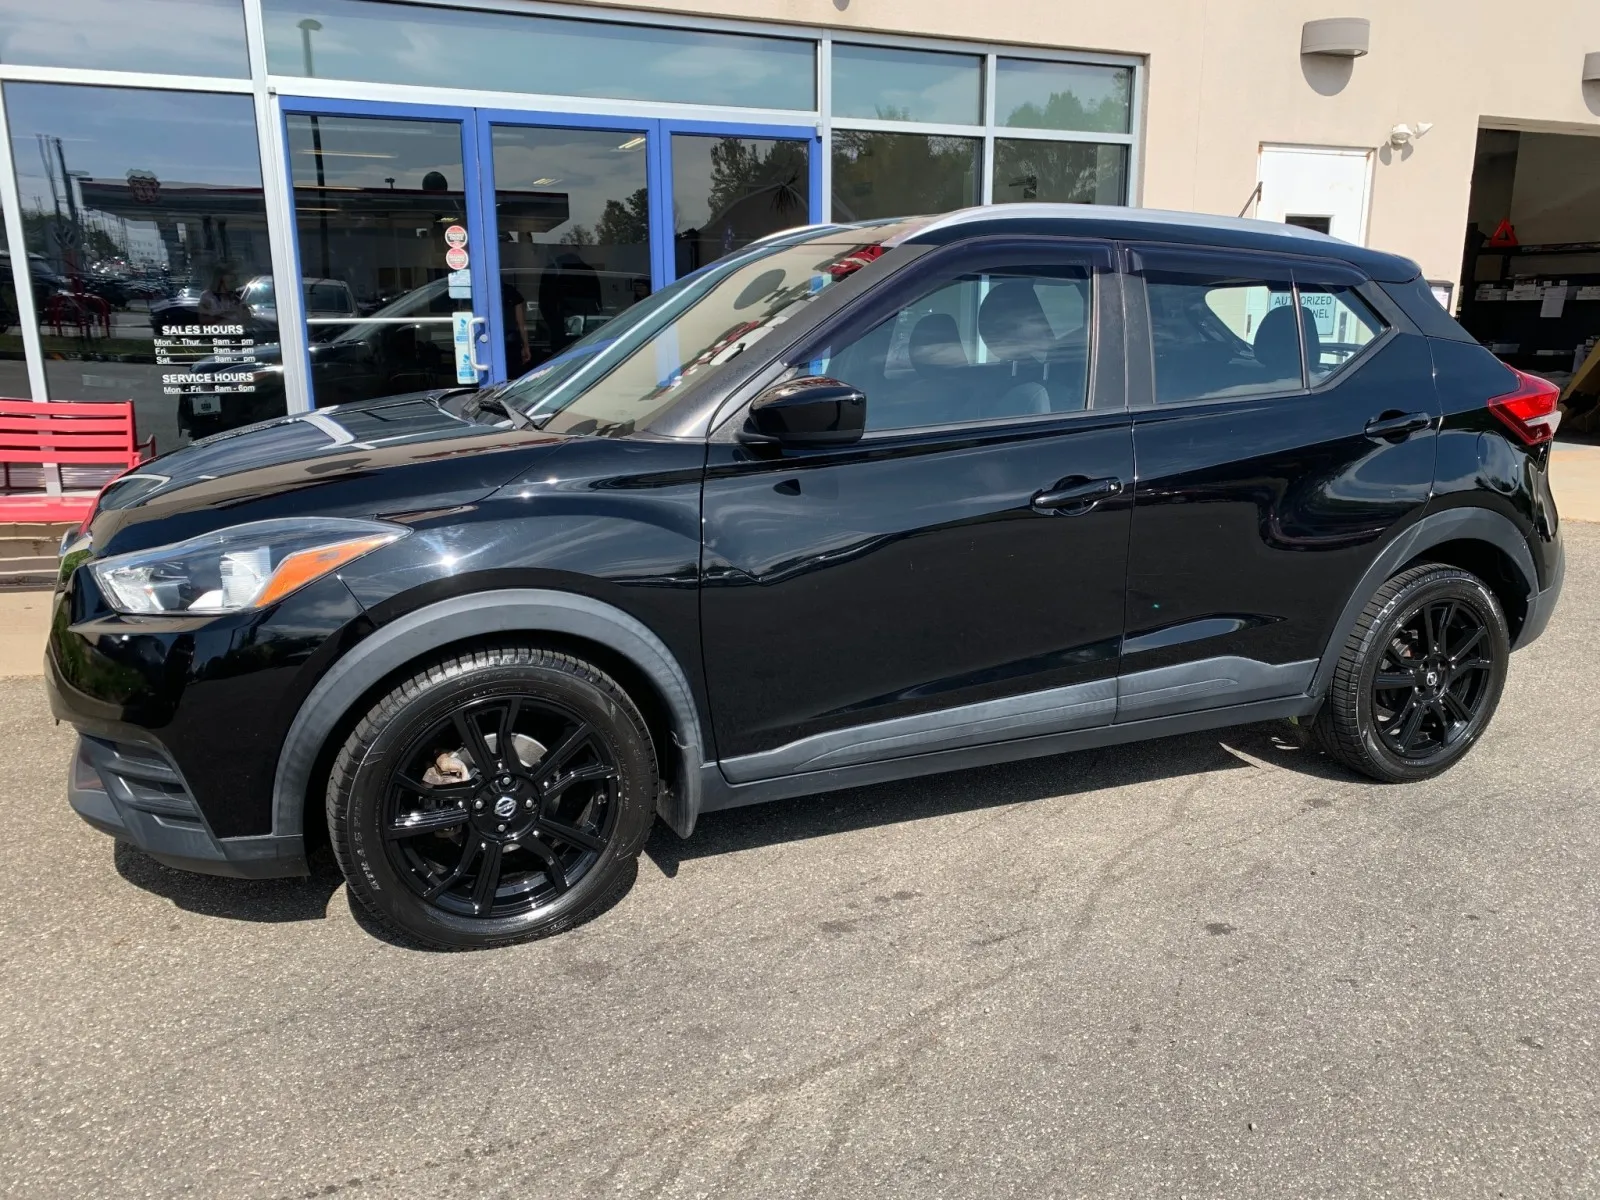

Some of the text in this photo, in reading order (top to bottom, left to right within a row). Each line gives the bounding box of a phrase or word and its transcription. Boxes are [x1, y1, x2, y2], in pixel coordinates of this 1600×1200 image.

[1274, 296, 1332, 306] AUTORIZED
[162, 325, 244, 335] SALES HOURS
[162, 373, 254, 383] SERVICE HOURS
